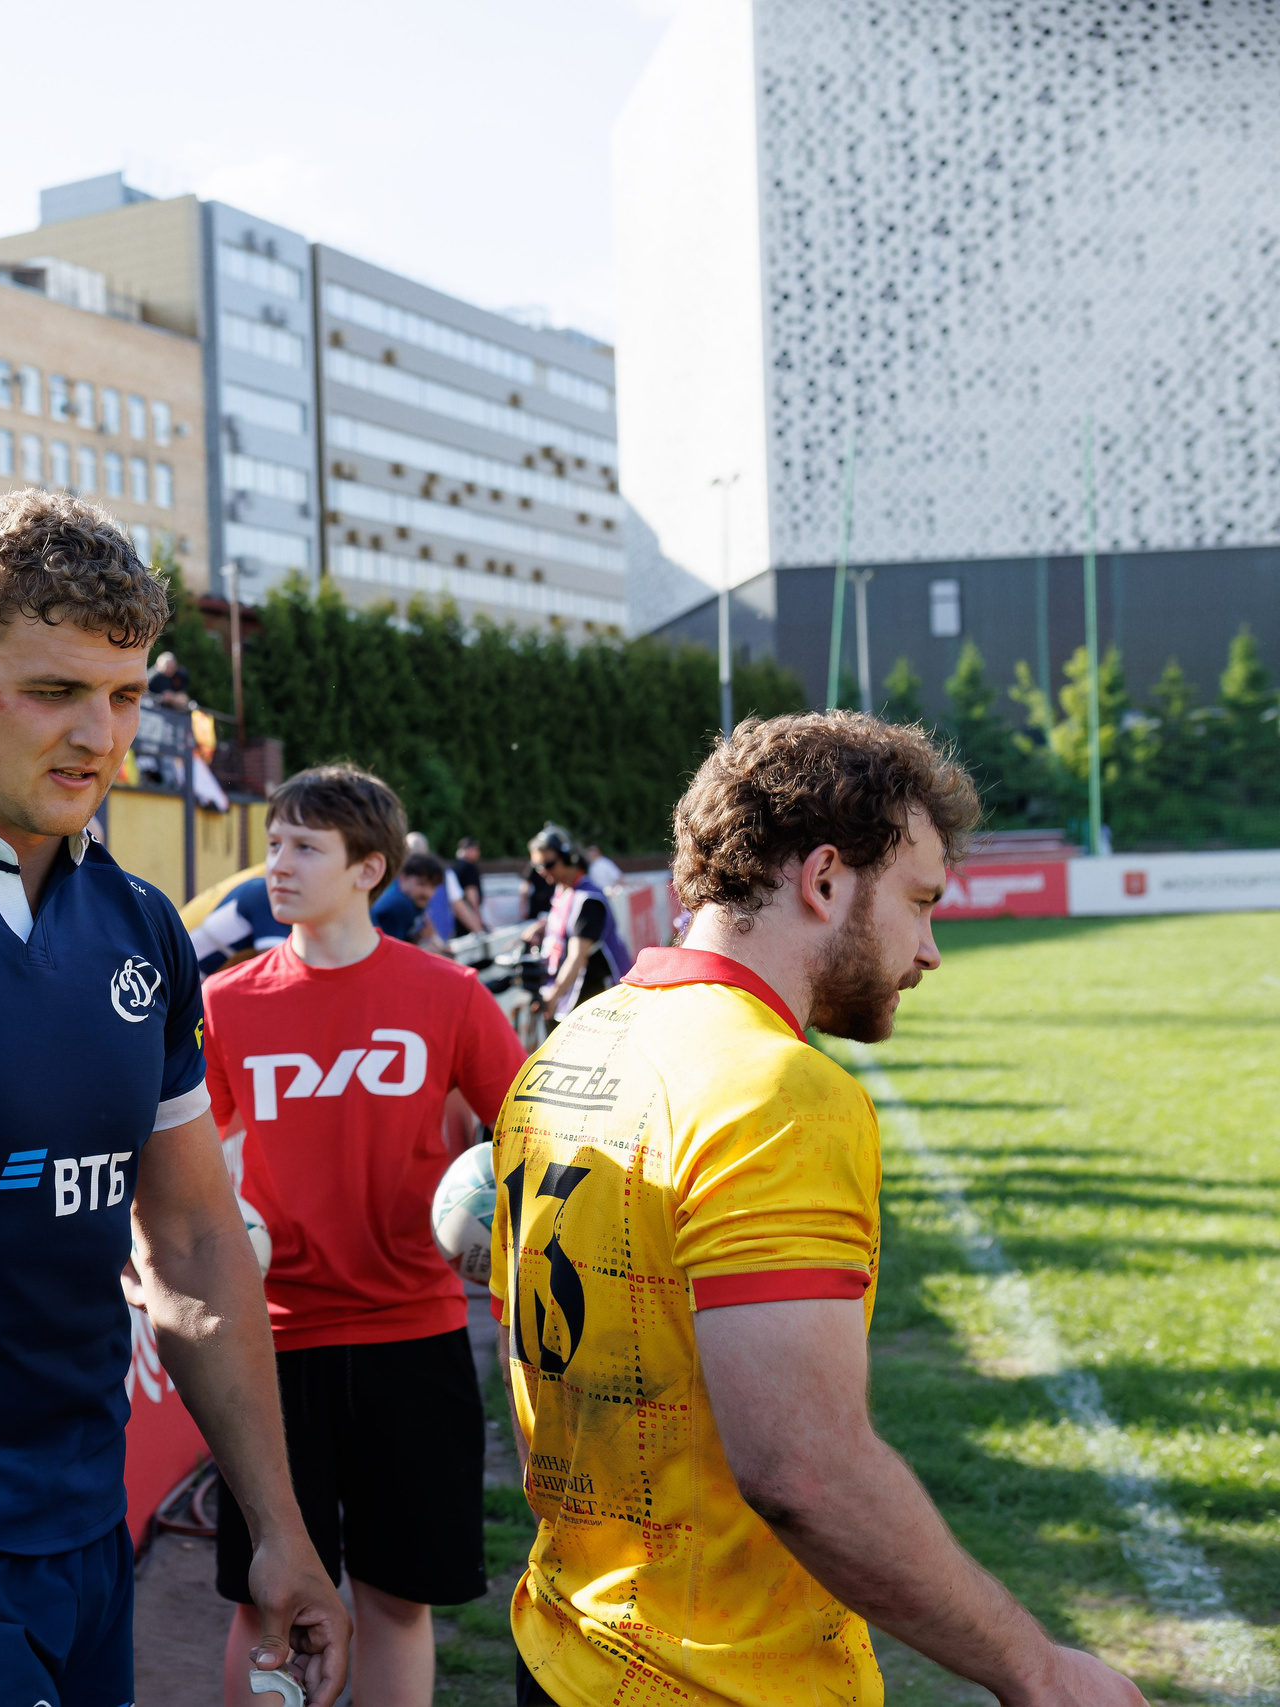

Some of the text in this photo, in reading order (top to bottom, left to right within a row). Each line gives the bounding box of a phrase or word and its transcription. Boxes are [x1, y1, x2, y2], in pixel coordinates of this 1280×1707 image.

[590, 1007, 638, 1025] centuri
[53, 1151, 133, 1217] ВТБ
[503, 1158, 591, 1374] 13
[642, 1518, 693, 1532] МОСКВ
